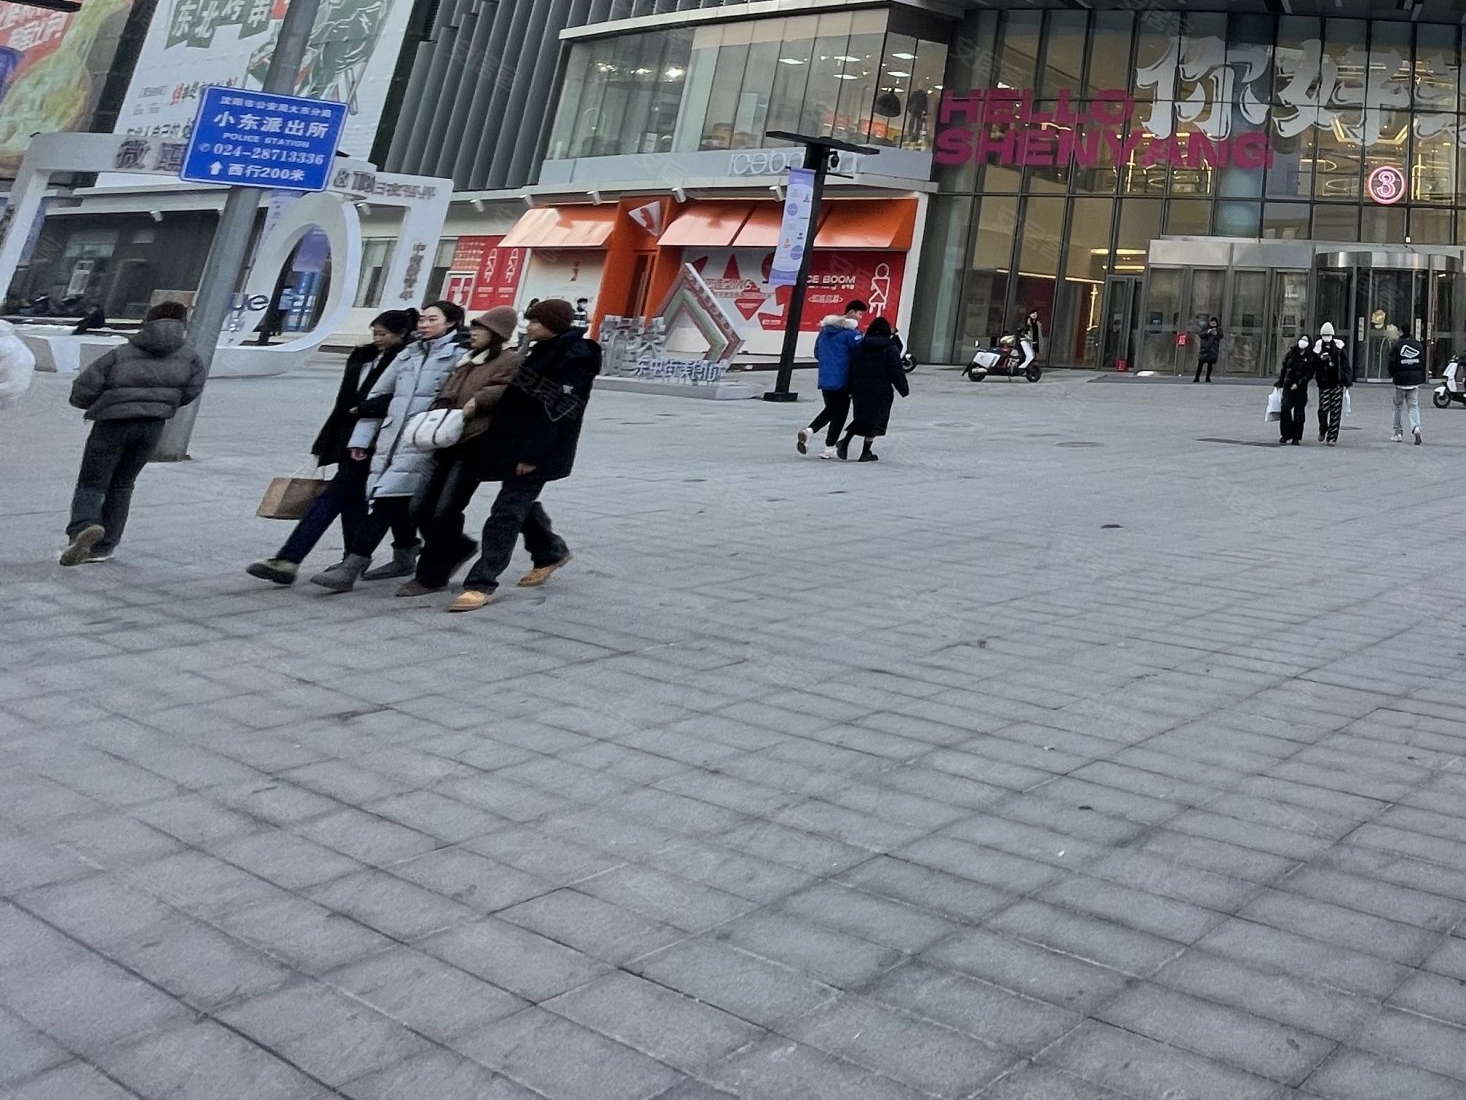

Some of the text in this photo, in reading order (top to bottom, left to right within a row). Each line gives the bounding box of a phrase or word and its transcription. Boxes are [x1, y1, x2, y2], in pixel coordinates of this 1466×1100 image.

[940, 88, 1135, 124] HELLO
[214, 111, 329, 139] 小东派出所
[222, 132, 309, 148] POLICE STATION
[935, 128, 1273, 169] SHENYANG
[213, 143, 325, 166] 024-28713336
[227, 162, 305, 181] 西行200米
[822, 275, 856, 284] BOOM
